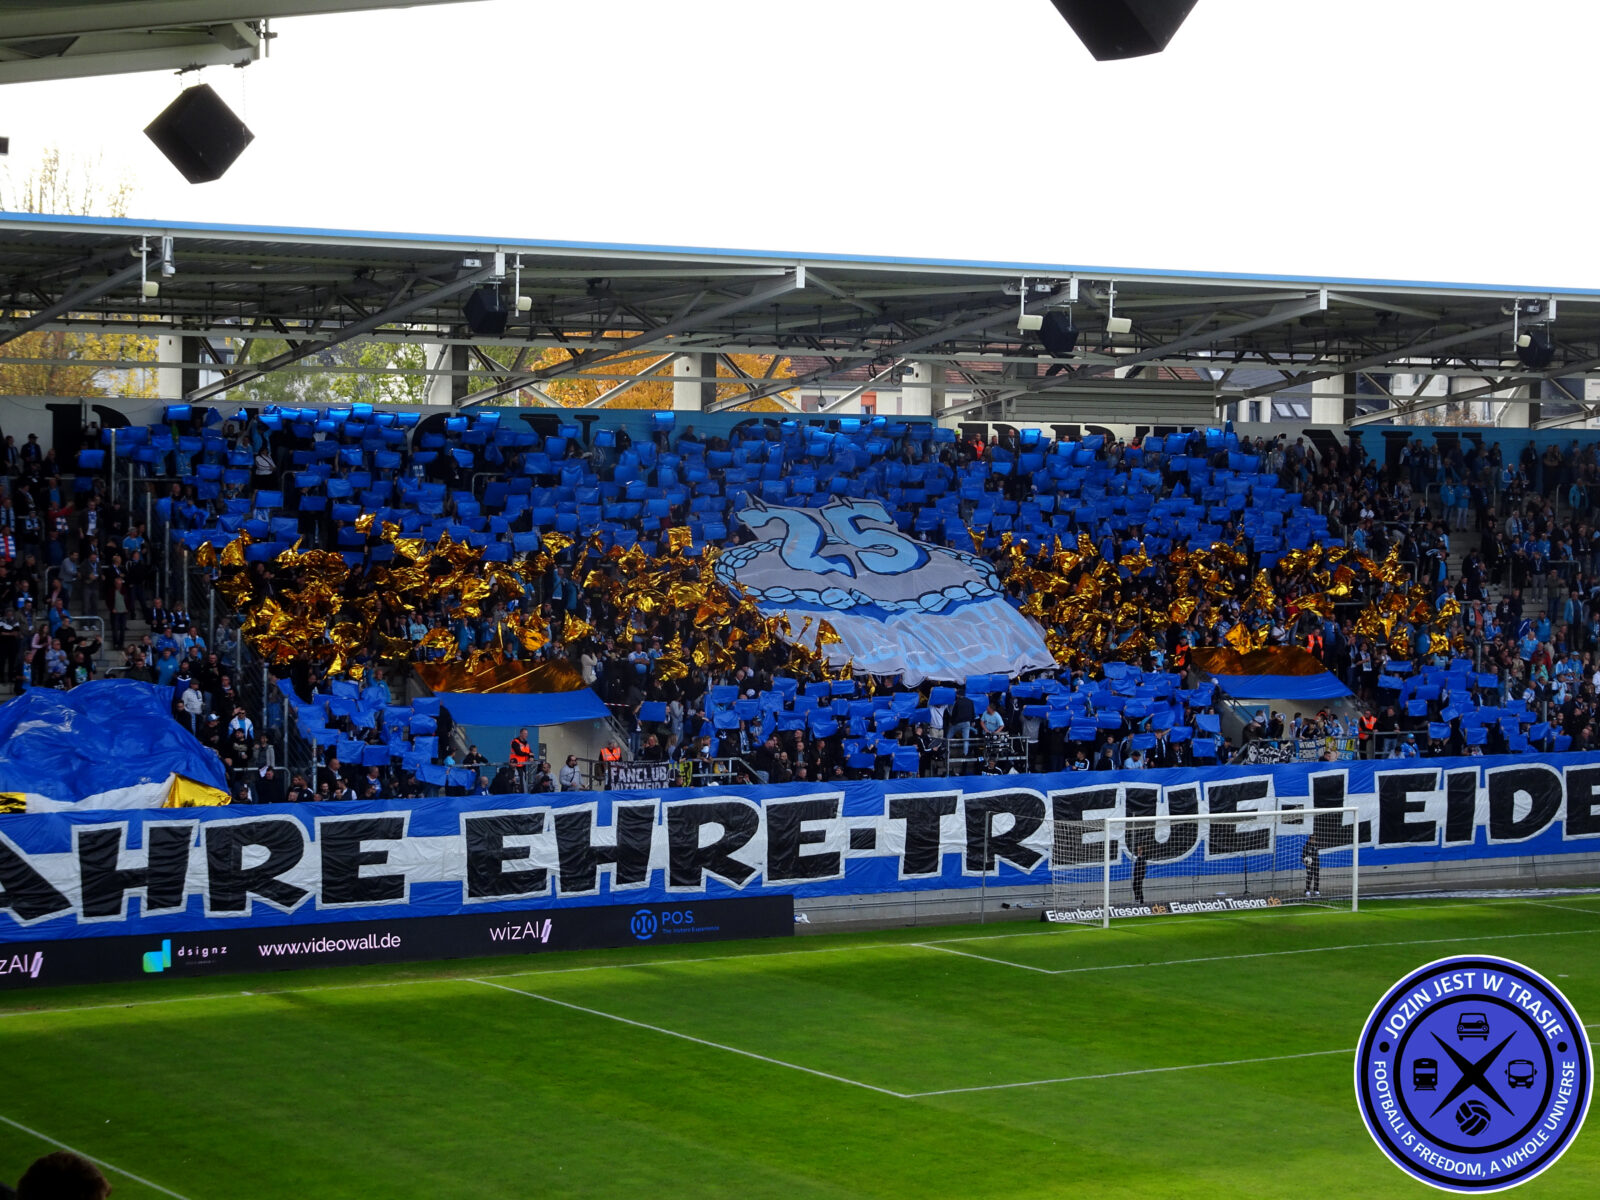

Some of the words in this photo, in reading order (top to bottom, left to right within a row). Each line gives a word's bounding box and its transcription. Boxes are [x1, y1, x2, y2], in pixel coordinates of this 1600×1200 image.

[735, 497, 932, 578] 25
[611, 766, 668, 783] FANCLUB
[1046, 907, 1106, 921] Eisenbach
[1170, 899, 1226, 914] Eisenbach
[177, 945, 228, 957] dsignz
[258, 933, 402, 956] www.videowall.de
